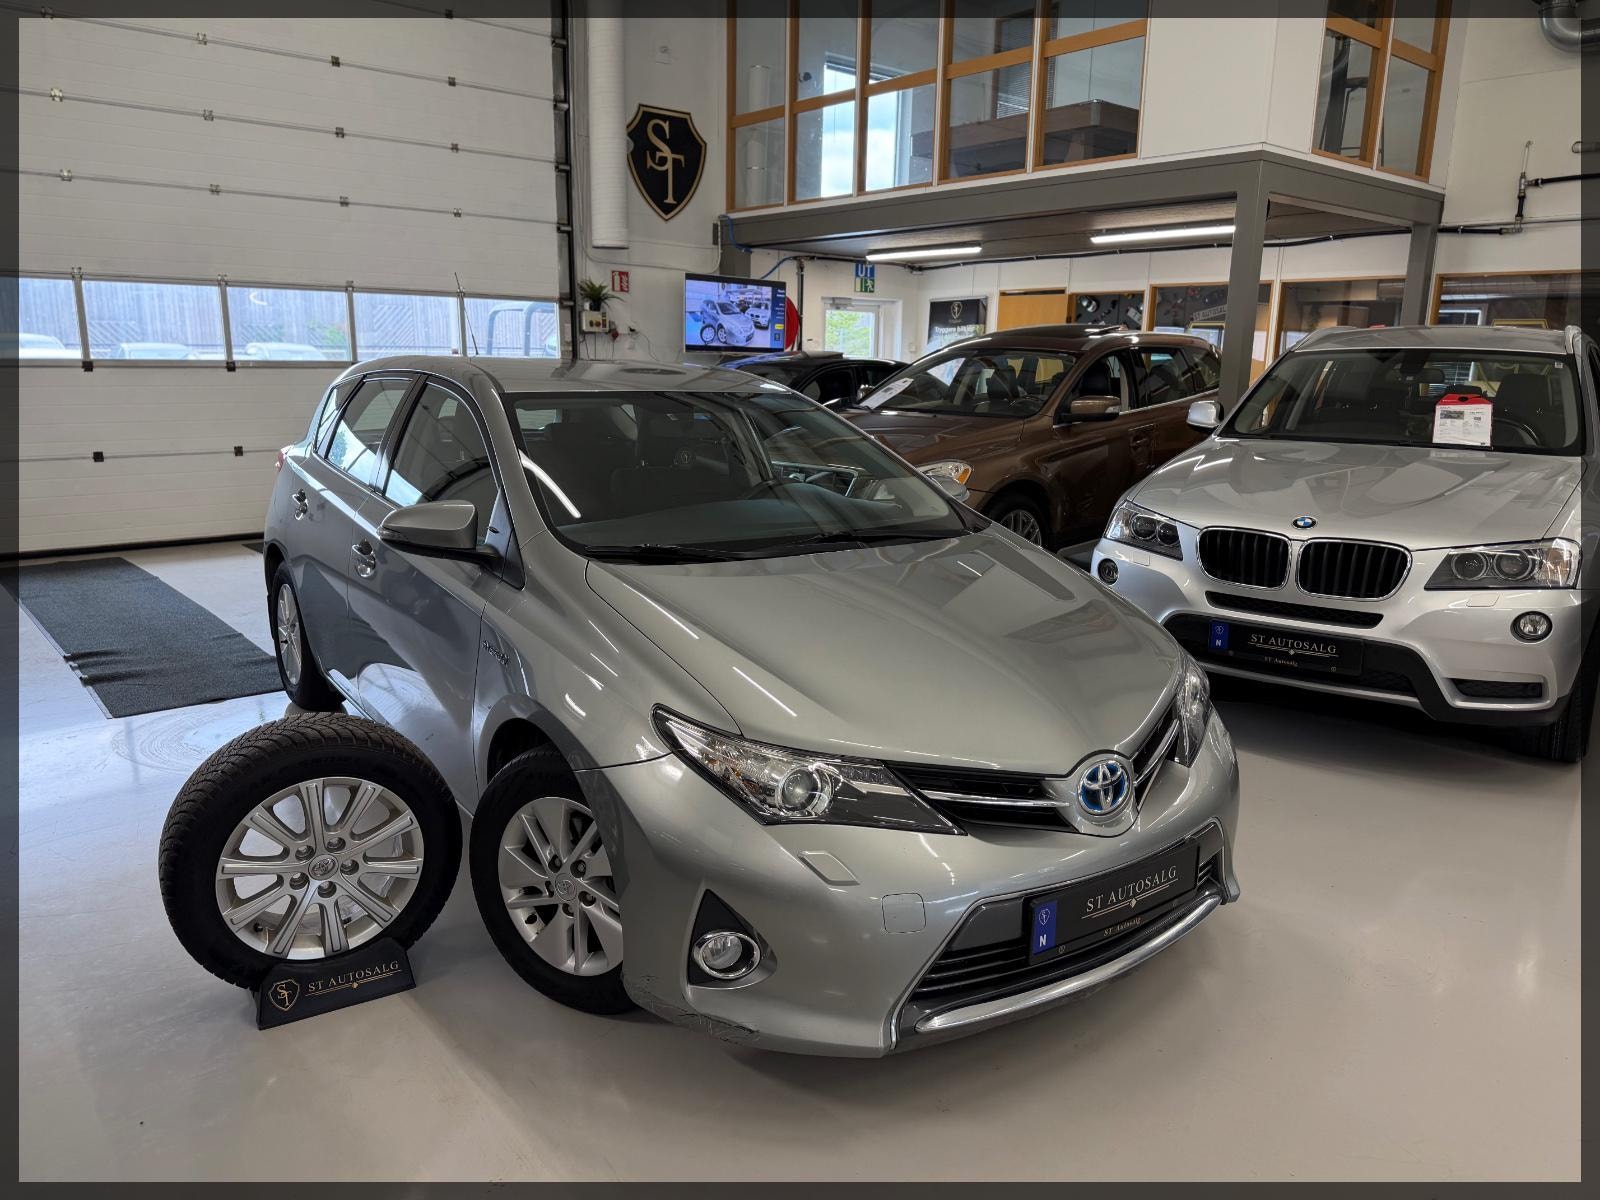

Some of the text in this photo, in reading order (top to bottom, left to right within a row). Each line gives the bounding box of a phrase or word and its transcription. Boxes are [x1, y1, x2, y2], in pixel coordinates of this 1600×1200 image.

[858, 263, 873, 277] UT
[1251, 634, 1337, 654] ST AUTOSALG
[1086, 865, 1177, 912] ST AUTOSALG
[1103, 926, 1114, 936] ST
[1039, 934, 1047, 947] N
[308, 961, 399, 992] ST AUTOSALG
